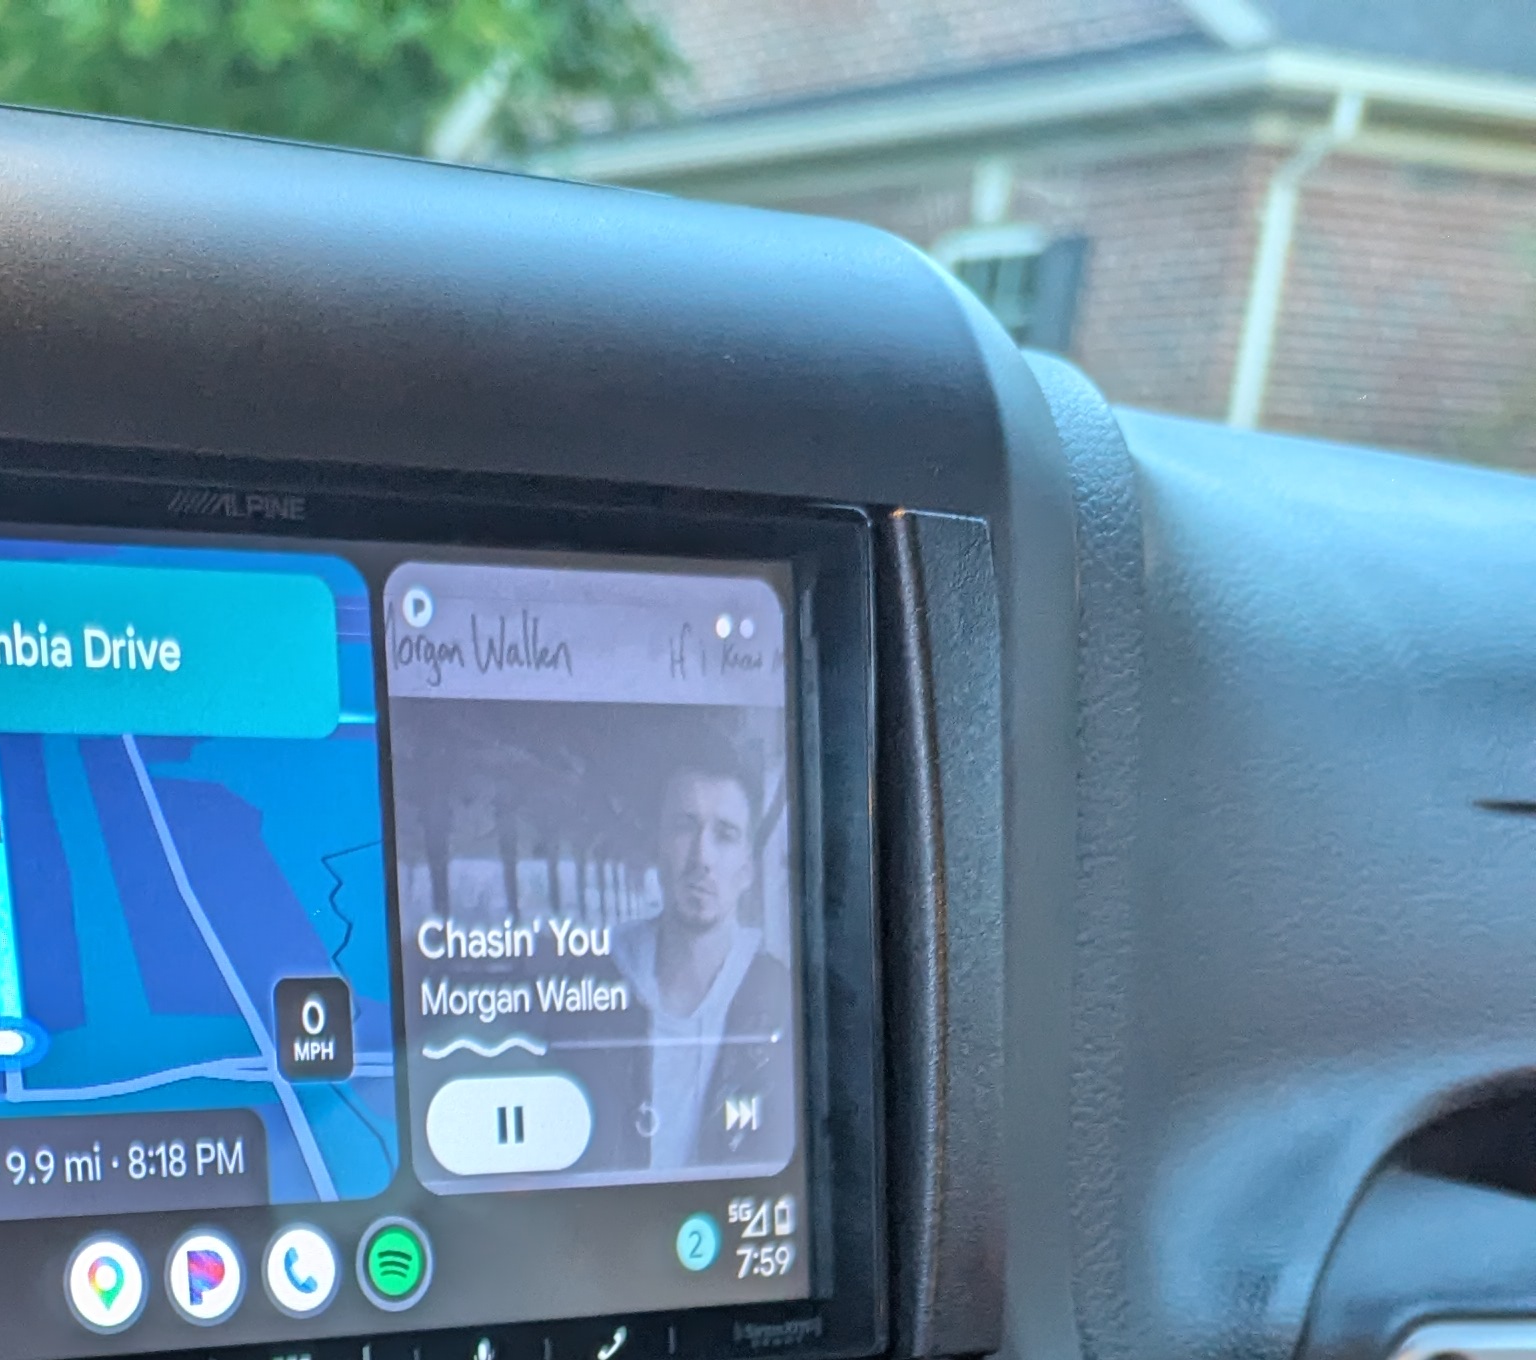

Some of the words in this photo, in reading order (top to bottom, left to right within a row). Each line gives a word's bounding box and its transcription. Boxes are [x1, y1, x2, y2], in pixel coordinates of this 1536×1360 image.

[84, 628, 183, 672] Drive
[471, 609, 573, 676] Wallen
[417, 920, 541, 960] Chasin'
[549, 922, 611, 957] You
[421, 984, 531, 1022] Morgan
[536, 982, 627, 1013] Wallen
[294, 1040, 334, 1064] MPH
[5, 1150, 56, 1186] 9.9
[64, 1143, 104, 1183] mi
[127, 1141, 188, 1180] 8:18
[196, 1136, 245, 1176] PM
[688, 1231, 703, 1259] 2
[736, 1246, 791, 1279] 7:59
